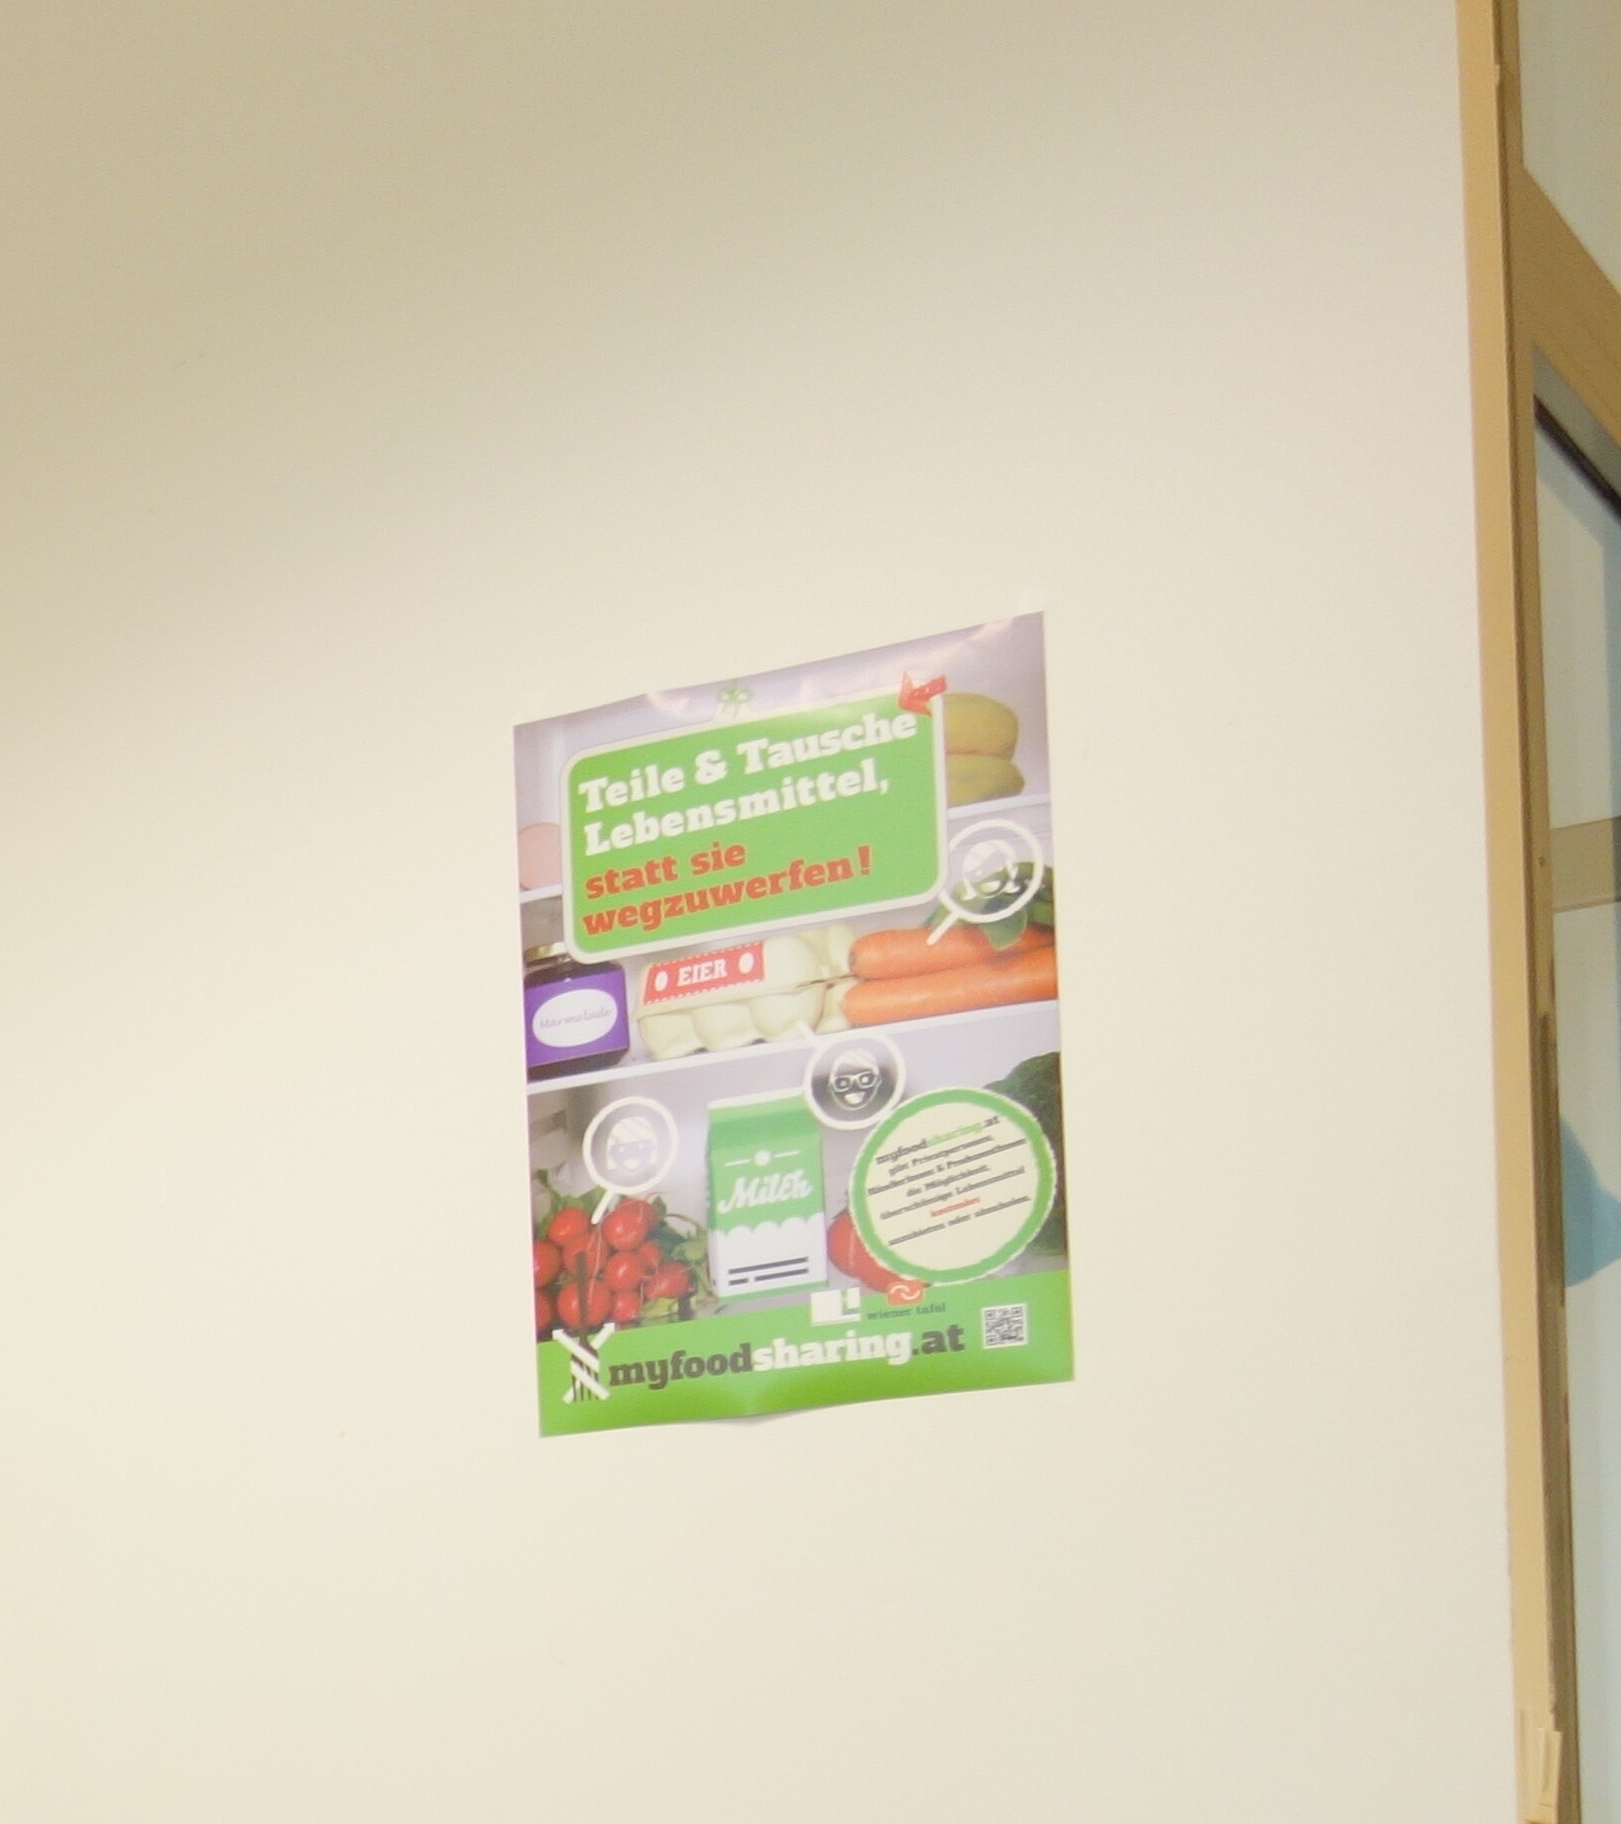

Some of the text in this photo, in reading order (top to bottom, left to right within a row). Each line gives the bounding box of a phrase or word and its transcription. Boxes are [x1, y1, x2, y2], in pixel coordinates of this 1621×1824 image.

[578, 712, 919, 814] Teile & Tausche
[582, 757, 889, 857] Lebensmittel,
[582, 844, 873, 937] wegzuwerfen!
[584, 840, 747, 901] statt sie
[676, 958, 728, 987] EIER
[717, 1162, 813, 1213] Milch
[866, 1302, 946, 1321] wiener tafel
[608, 1322, 966, 1390] myfoodsharing.at
